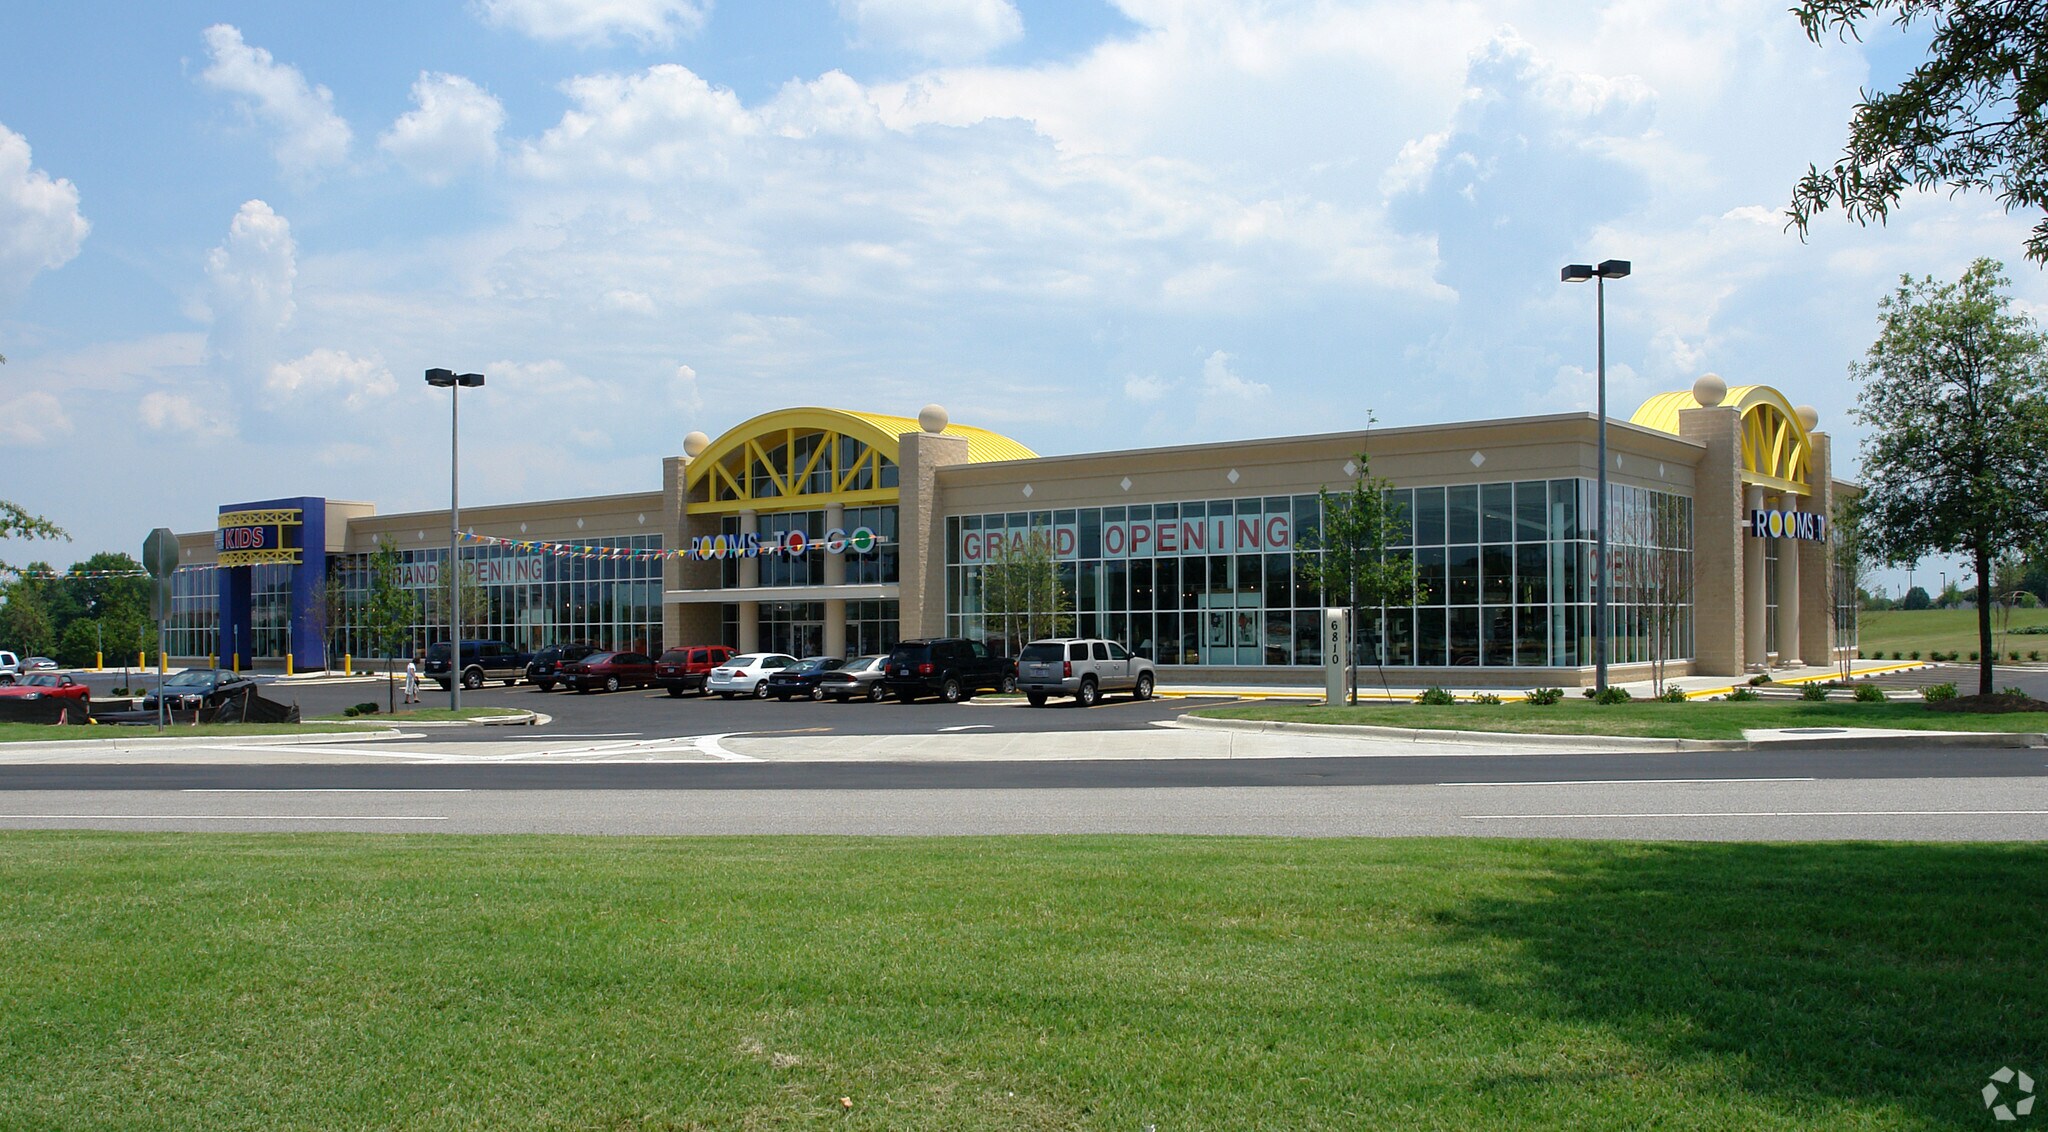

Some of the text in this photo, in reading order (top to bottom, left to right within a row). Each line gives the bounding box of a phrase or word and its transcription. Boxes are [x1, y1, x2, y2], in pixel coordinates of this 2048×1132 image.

[225, 526, 264, 549] KIDS
[963, 516, 1289, 560] GRAND OPENING
[1756, 509, 1813, 540] ROOMS
[691, 526, 877, 561] ROOMS TO GO
[389, 558, 543, 586] RAND PENING
[1331, 620, 1339, 664] 6810
